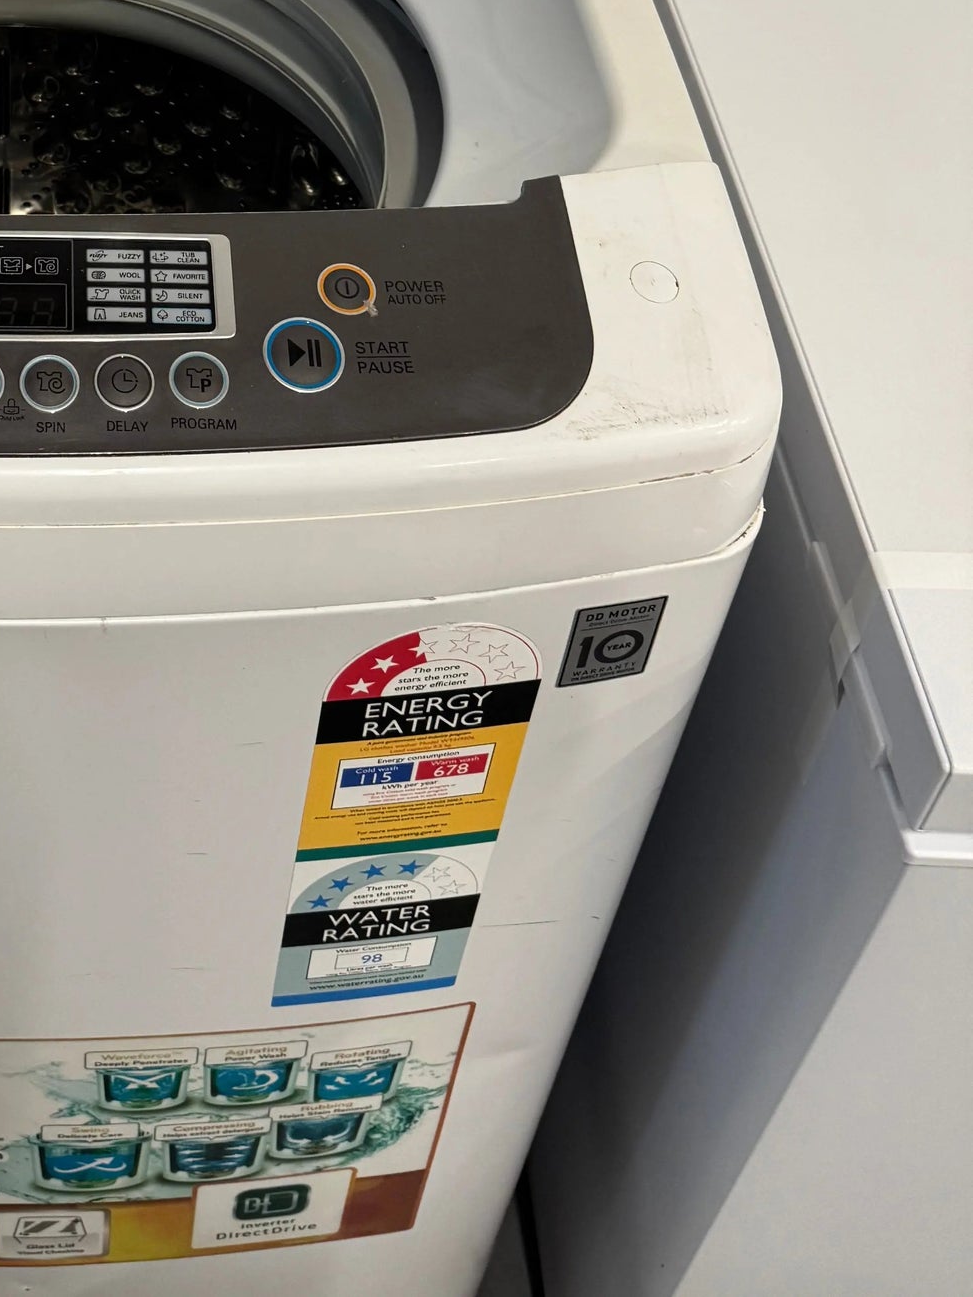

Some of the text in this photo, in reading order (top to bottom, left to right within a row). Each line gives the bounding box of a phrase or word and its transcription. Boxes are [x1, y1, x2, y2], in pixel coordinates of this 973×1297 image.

[385, 280, 444, 292] POWER
[388, 294, 446, 304] AUTO OFF
[355, 341, 409, 354] START
[357, 361, 415, 374] PAUSE
[36, 421, 66, 433] SPIN
[107, 420, 149, 432] DELAY
[171, 417, 237, 430] PROGRAM
[585, 604, 657, 622] DD MOTOR
[576, 629, 644, 669] 10
[606, 641, 632, 651] YEAR
[434, 664, 461, 672] more
[572, 662, 636, 677] WARRANTY
[394, 679, 467, 692] energy efficient
[398, 676, 421, 684] stars
[364, 690, 493, 719] ENERGY
[361, 710, 484, 738] RATING
[377, 750, 460, 764] Energy consumption
[431, 758, 457, 766] Warm
[433, 763, 469, 777] 678
[360, 771, 392, 785] 115
[328, 904, 430, 927] WATER
[322, 919, 431, 942] RATING
[361, 953, 383, 964] 98
[334, 1047, 391, 1059] Rotating
